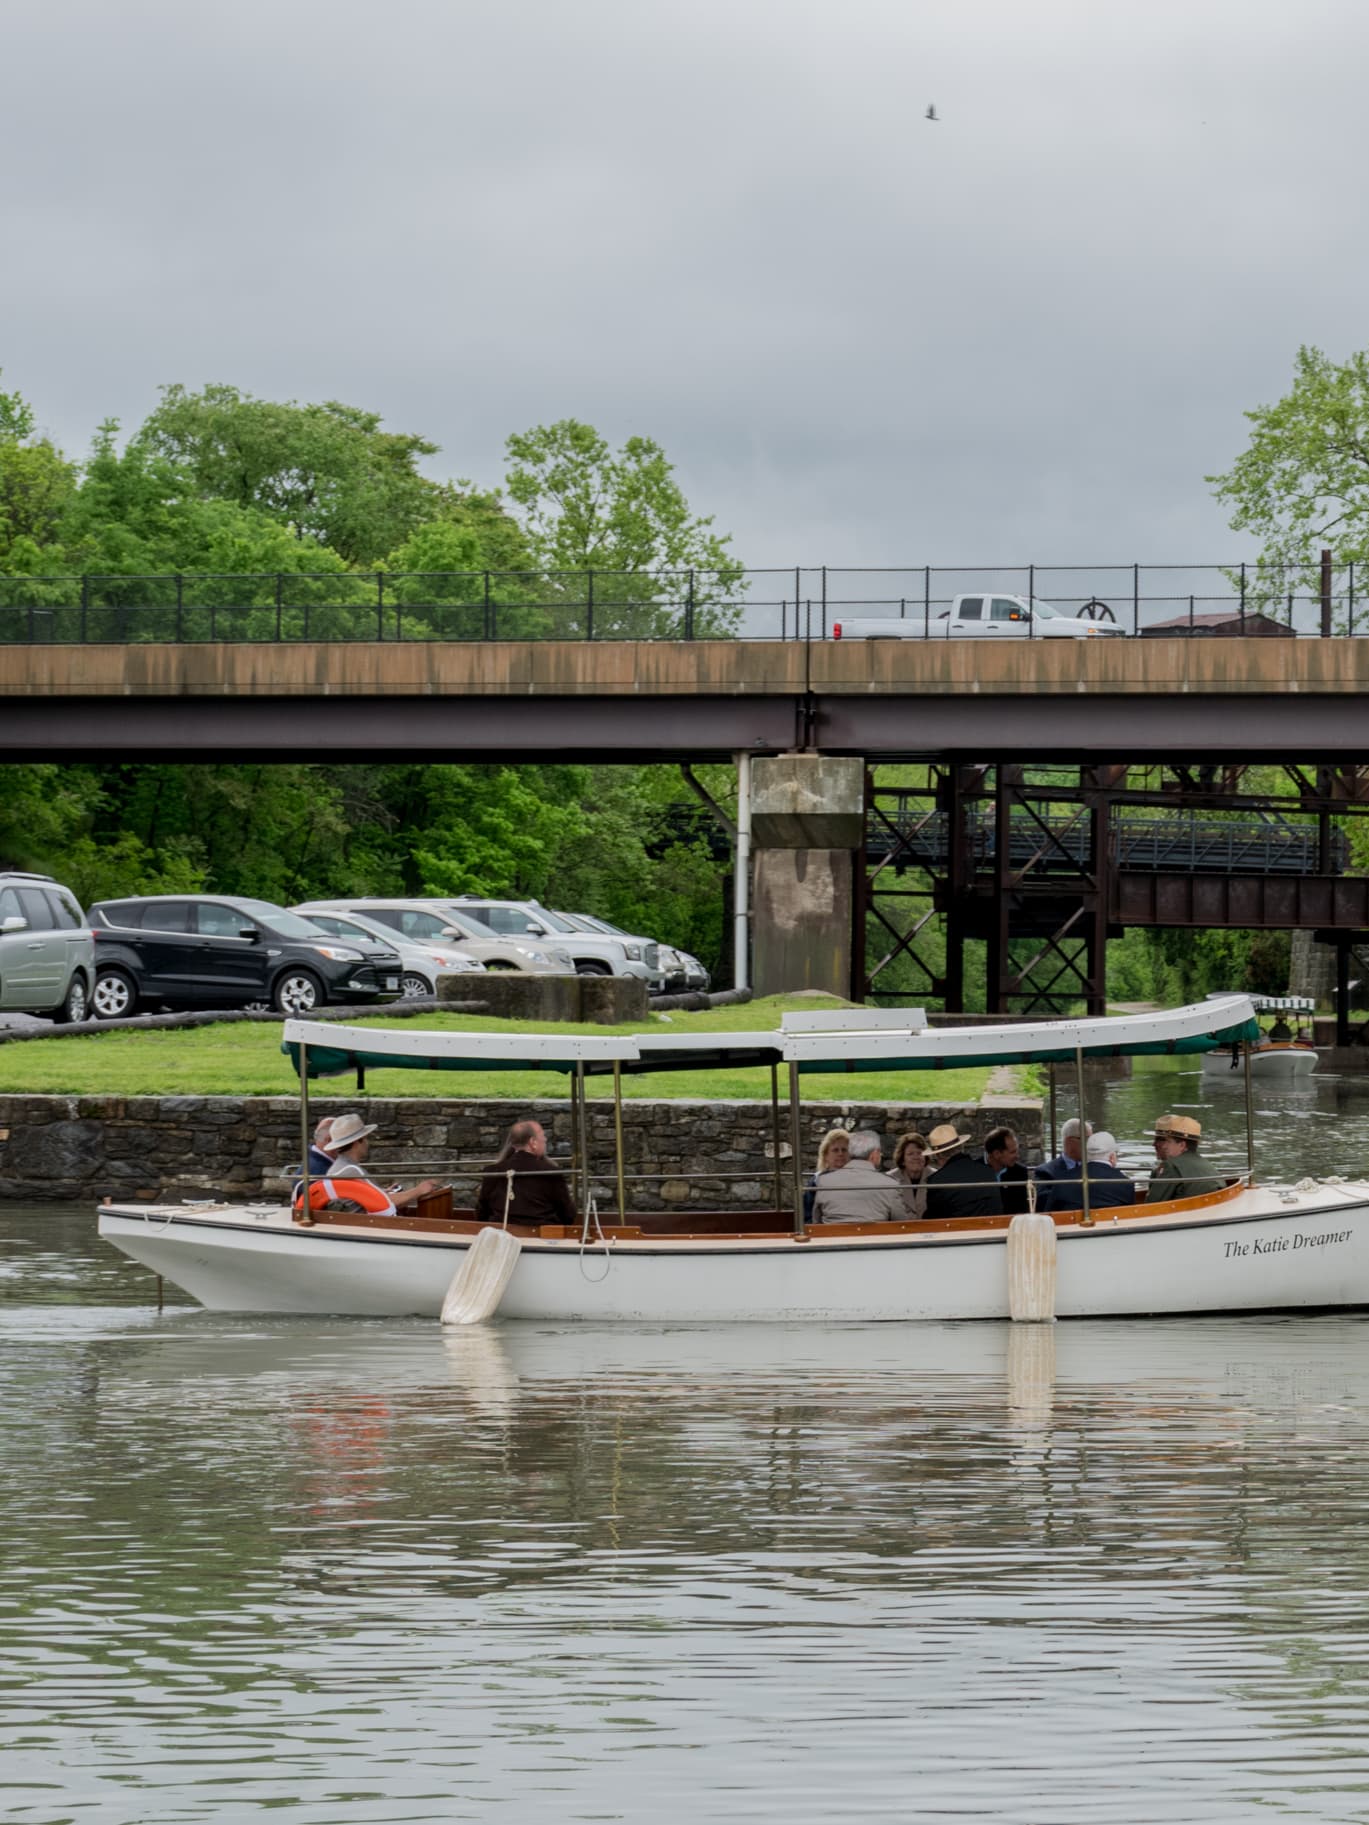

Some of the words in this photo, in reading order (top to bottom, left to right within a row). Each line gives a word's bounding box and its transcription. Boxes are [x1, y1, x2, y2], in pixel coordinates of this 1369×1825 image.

[1224, 1241, 1249, 1258] The
[1252, 1236, 1290, 1255] Katie
[1293, 1229, 1353, 1249] Dreamer
